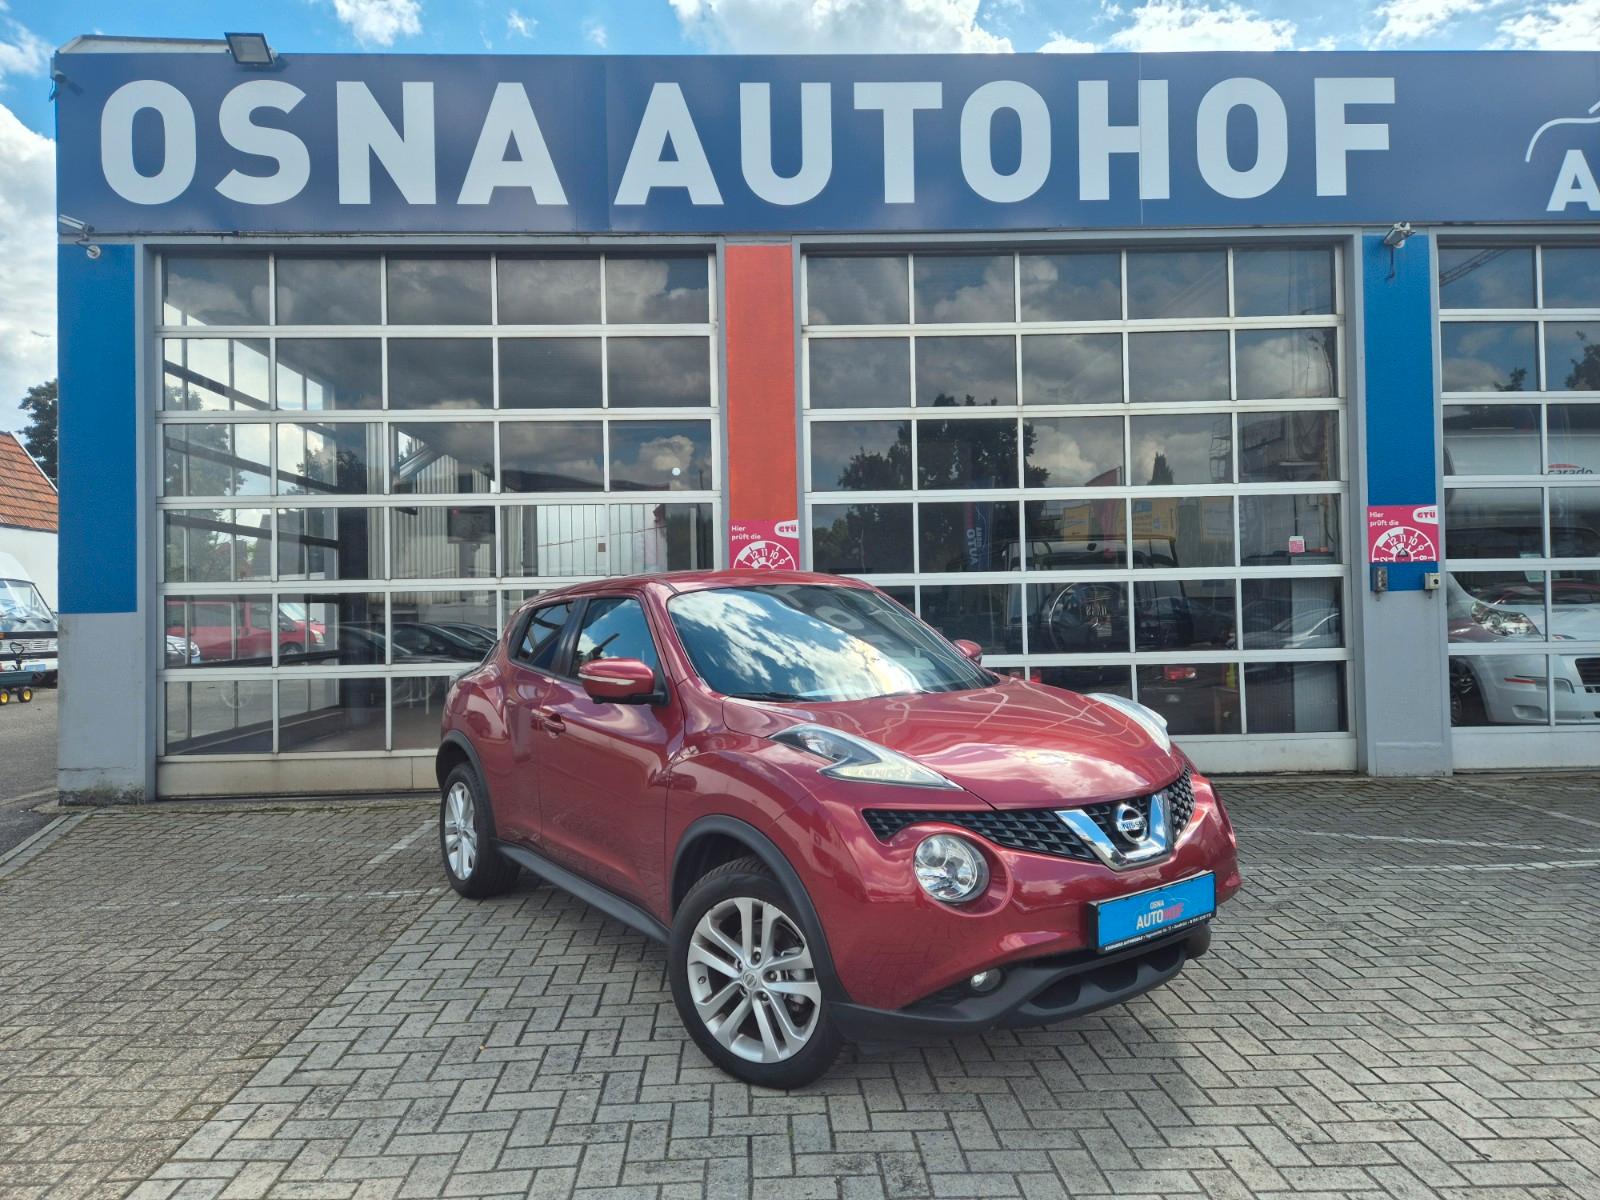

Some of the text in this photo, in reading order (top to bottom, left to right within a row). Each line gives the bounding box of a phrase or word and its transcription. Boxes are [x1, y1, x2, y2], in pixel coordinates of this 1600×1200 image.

[100, 77, 1396, 206] OSNA AUTOHOF
[1546, 149, 1600, 211] A
[1417, 510, 1436, 518] GTÜ
[1369, 519, 1388, 527] prüft
[778, 524, 797, 533] GTÜ
[731, 533, 749, 541] prüft
